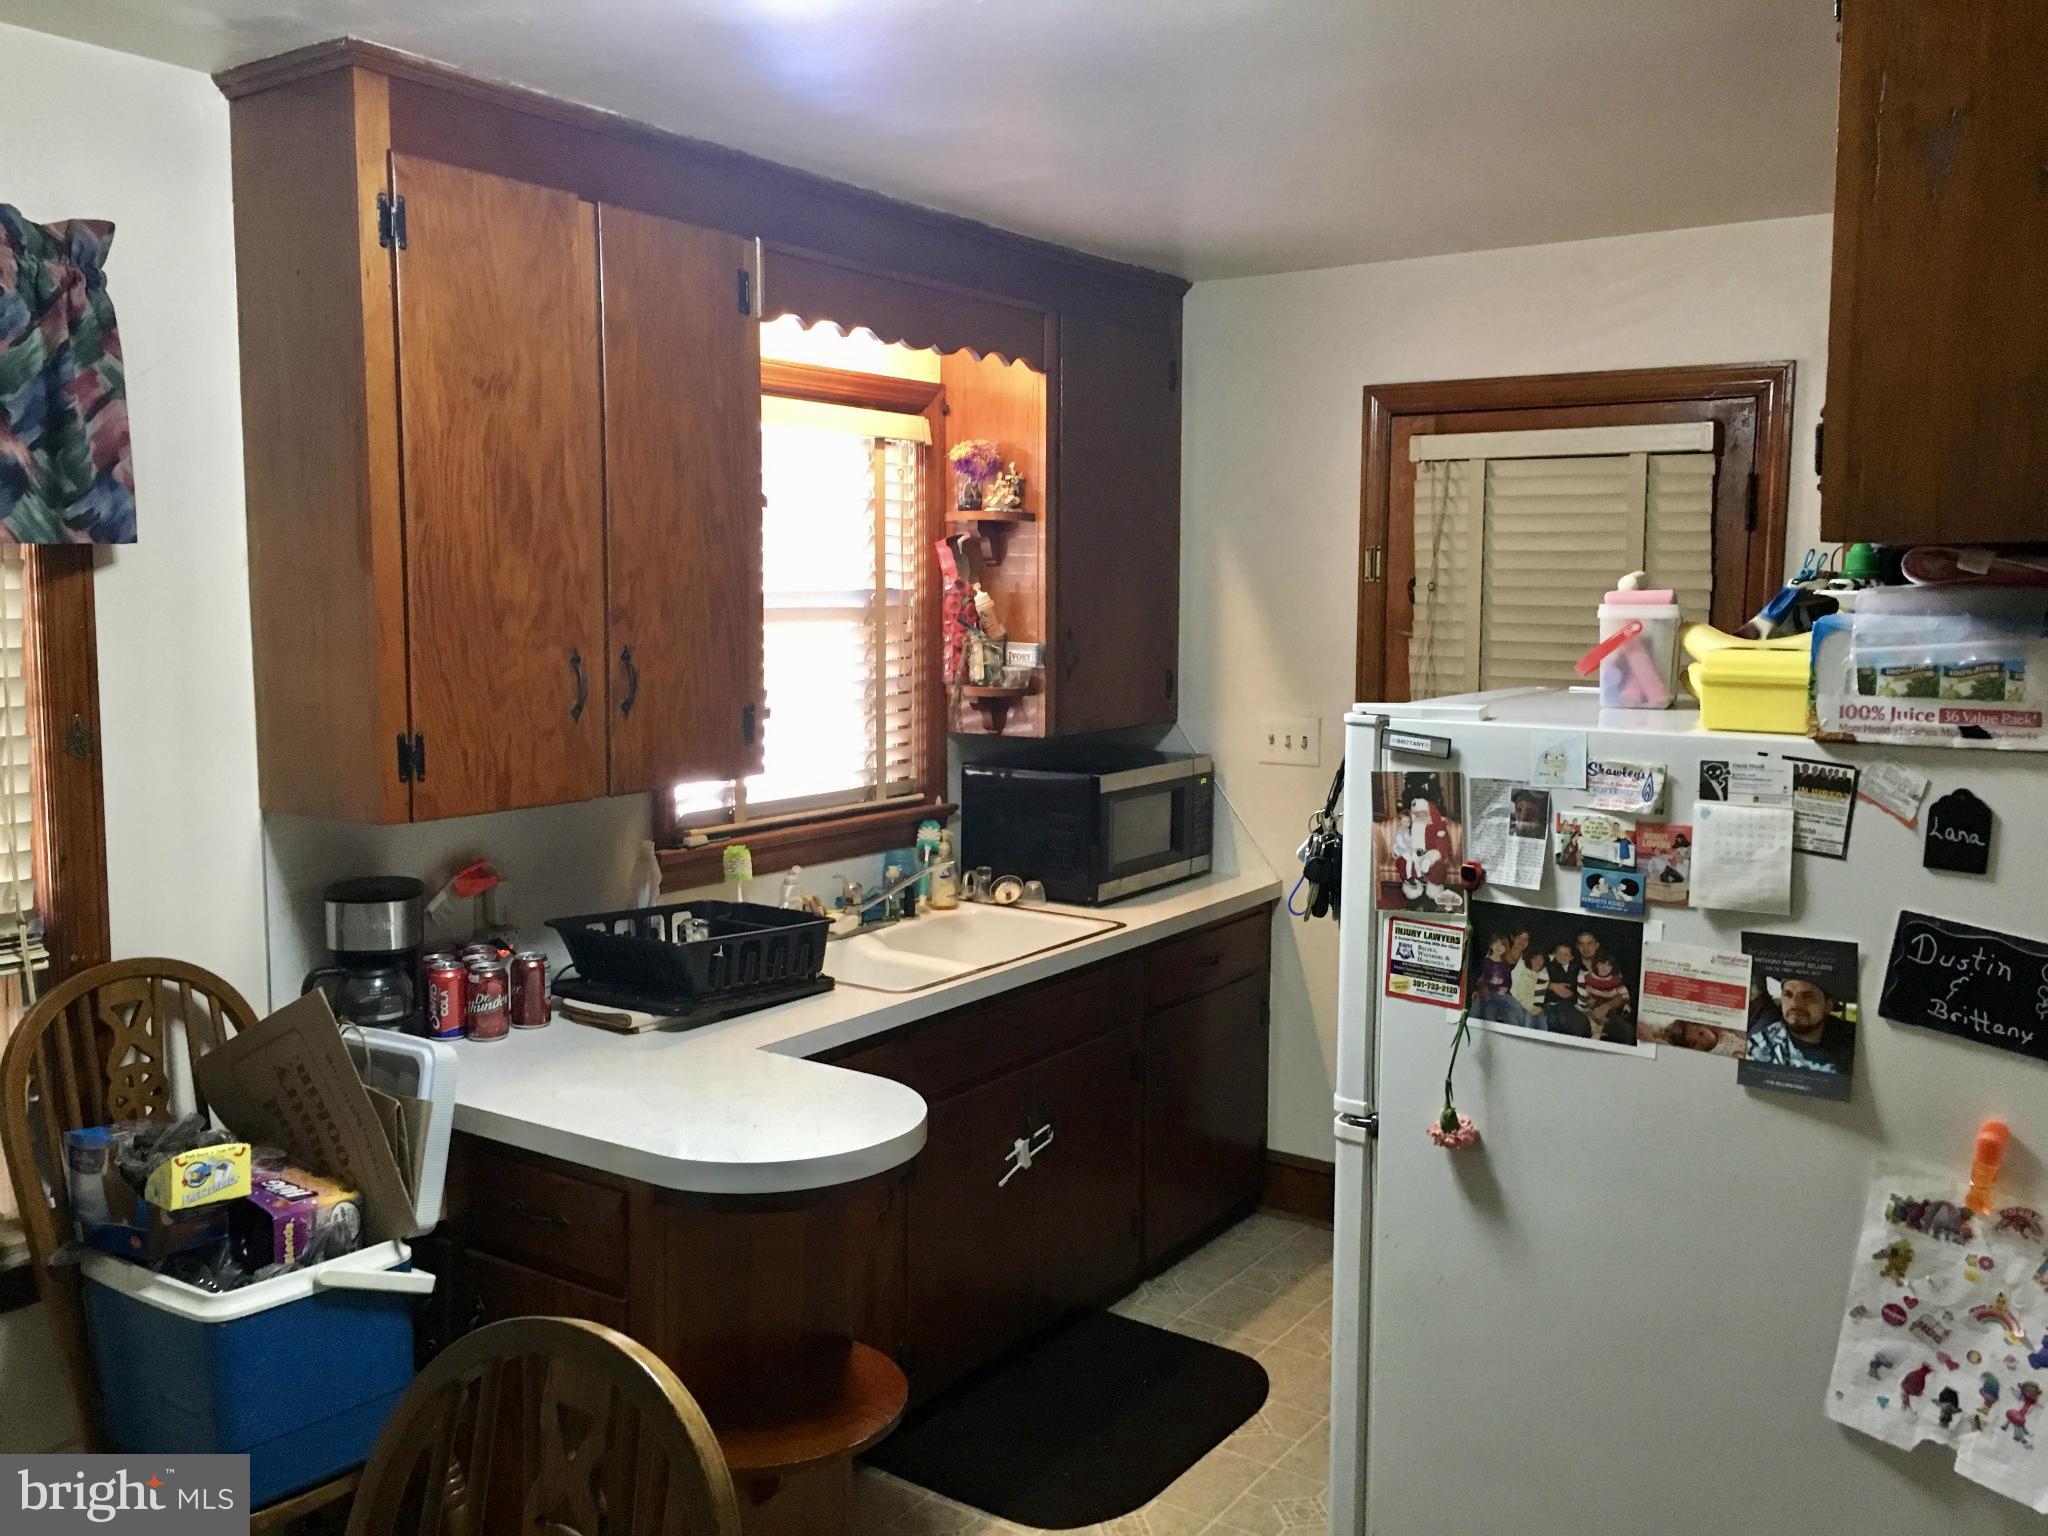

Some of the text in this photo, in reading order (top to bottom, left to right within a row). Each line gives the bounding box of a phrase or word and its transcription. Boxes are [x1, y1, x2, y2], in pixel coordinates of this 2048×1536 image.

[1839, 703, 1886, 721] 100%
[1889, 706, 1936, 724] Juice
[1944, 710, 1960, 724] 36
[1962, 710, 1998, 724] Value
[1929, 815, 1986, 846] Lana
[1394, 926, 1422, 938] INJURY
[1423, 931, 1461, 945] LAWYERS
[1907, 933, 2012, 982] Dustin
[440, 990, 449, 1018] COLA
[1927, 998, 2035, 1045] Brittany
